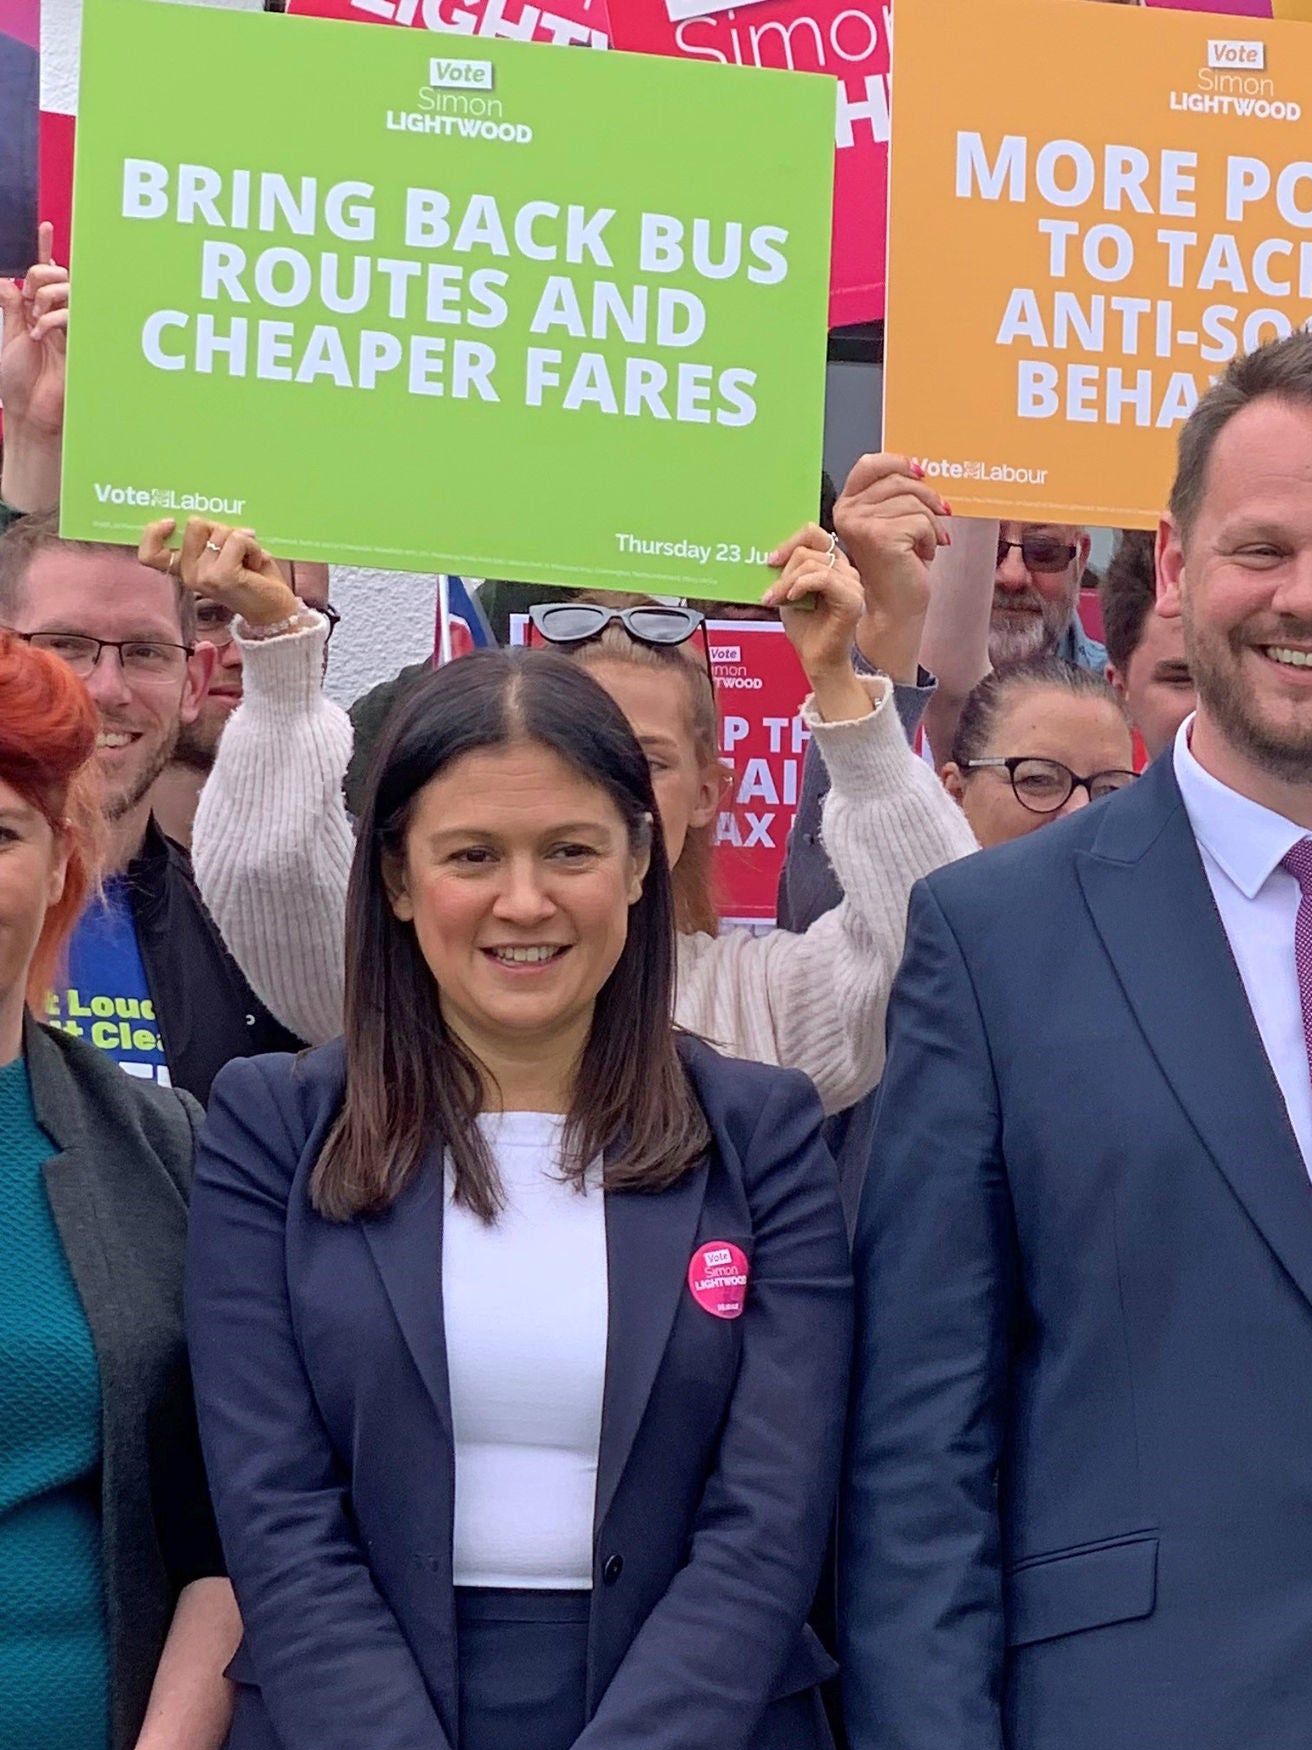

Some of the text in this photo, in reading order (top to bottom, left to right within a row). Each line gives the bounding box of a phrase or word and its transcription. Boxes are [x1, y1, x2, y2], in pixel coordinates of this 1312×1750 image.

[1214, 44, 1258, 63] Vote
[436, 62, 486, 82] Vote
[1198, 68, 1274, 96] Simon
[418, 86, 503, 117] Simon
[1170, 91, 1301, 121] LIGHTWOOD
[387, 110, 532, 143] LIGHTWOOD
[956, 131, 1198, 218] MORE
[121, 158, 789, 285] BRING BACK BUS
[1038, 218, 1134, 283] TO
[201, 240, 707, 348] ROUTES AND
[141, 310, 757, 427] CHEAPER FARES
[981, 462, 1048, 485] Labour
[94, 483, 246, 515] Vote Labour
[616, 533, 772, 565] Thursday 23 Ju
[711, 649, 737, 660] Vote
[704, 1266, 738, 1278] Simon
[707, 1253, 729, 1263] Vote
